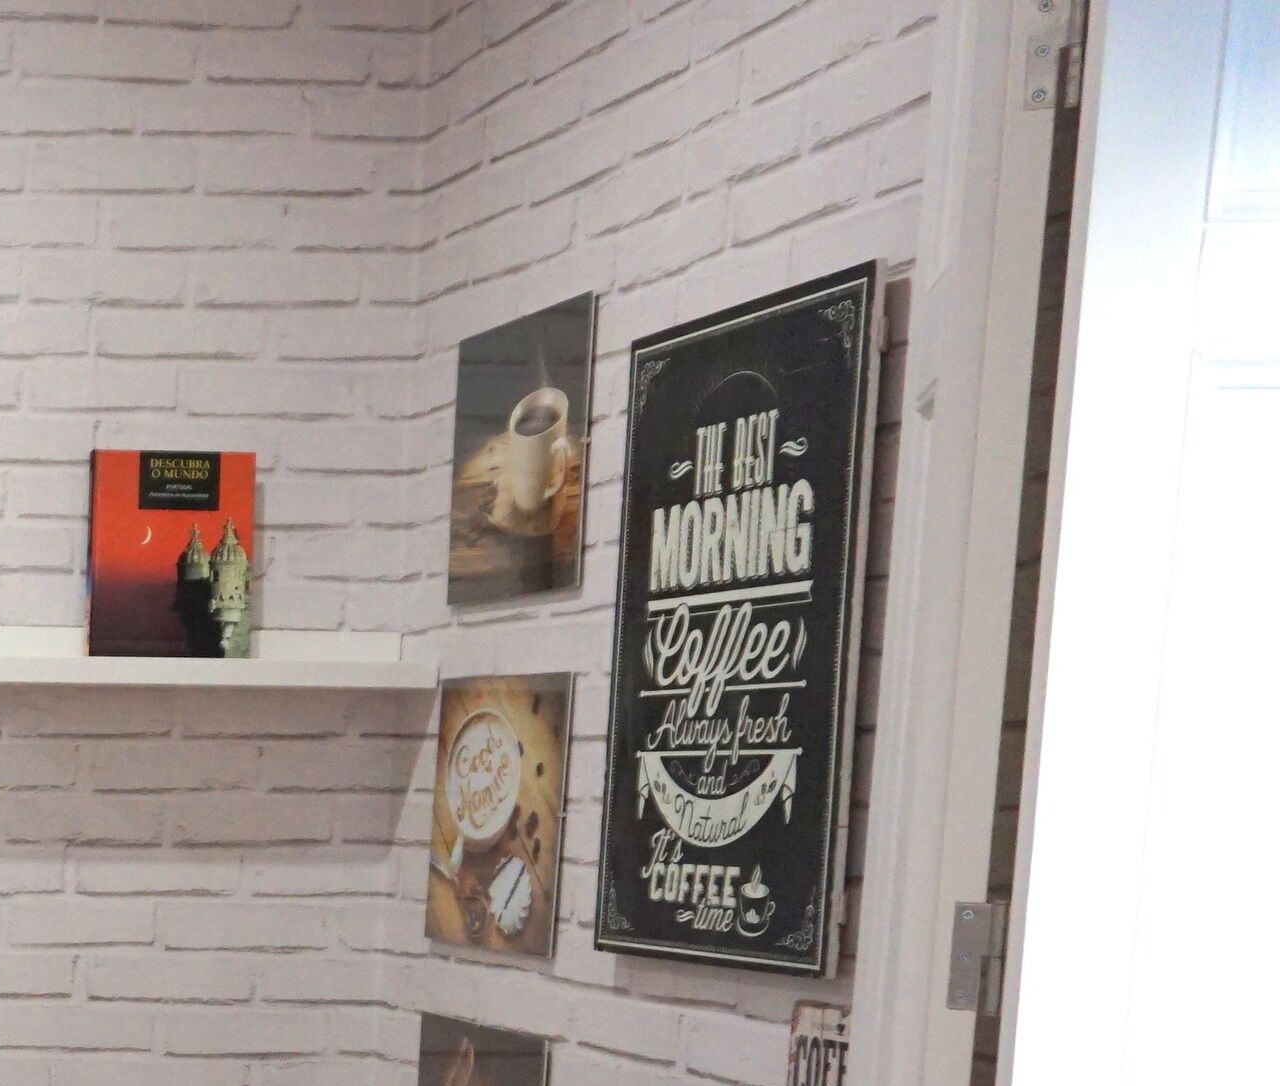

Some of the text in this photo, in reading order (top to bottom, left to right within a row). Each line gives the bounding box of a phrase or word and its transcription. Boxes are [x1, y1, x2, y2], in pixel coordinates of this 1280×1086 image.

[150, 458, 211, 469] DESCUBRA
[151, 468, 209, 479] O MUNDO
[694, 409, 779, 497] THE BEST
[650, 478, 814, 591] MORNING
[656, 602, 791, 718] Coffee
[648, 693, 792, 773] Always fresh
[697, 760, 728, 795] and
[674, 791, 750, 843] Natural
[650, 862, 740, 908] COFFEE
[692, 898, 735, 932] time
